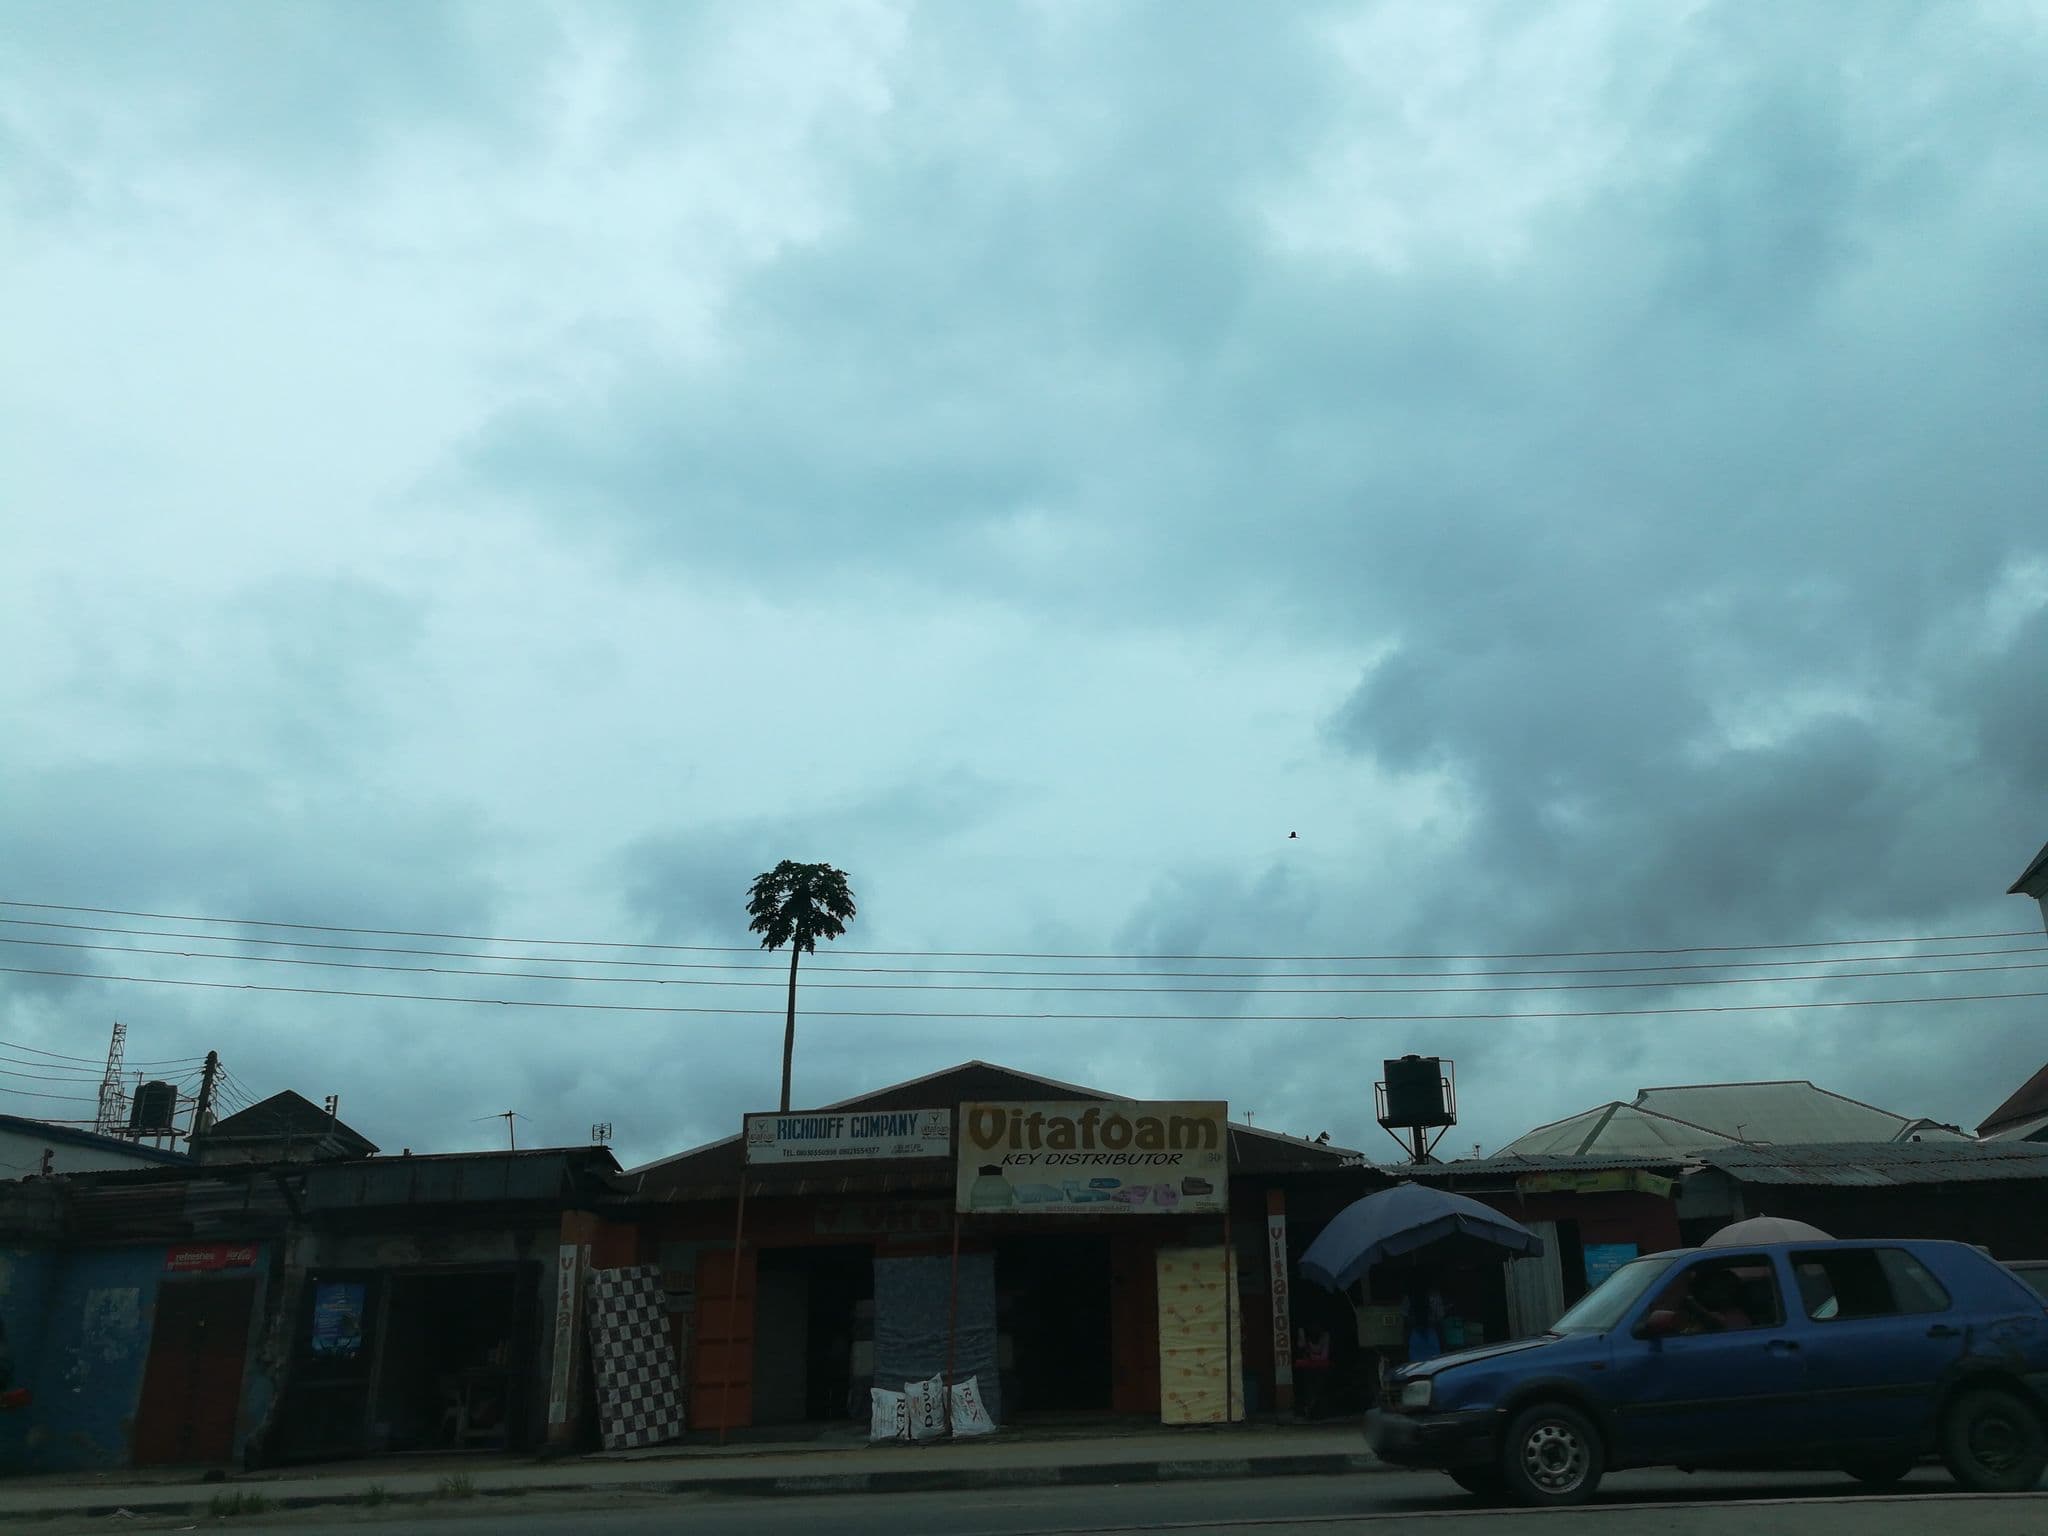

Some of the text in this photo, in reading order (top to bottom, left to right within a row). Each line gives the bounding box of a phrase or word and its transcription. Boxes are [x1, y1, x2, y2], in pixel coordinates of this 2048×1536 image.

[851, 1113, 918, 1138] COMPANY
[968, 1107, 1218, 1150] Vitafoam
[1001, 1153, 1184, 1165] KEY DISTRIBUTOR
[896, 1397, 906, 1439] REX
[922, 1382, 933, 1428] Dove
